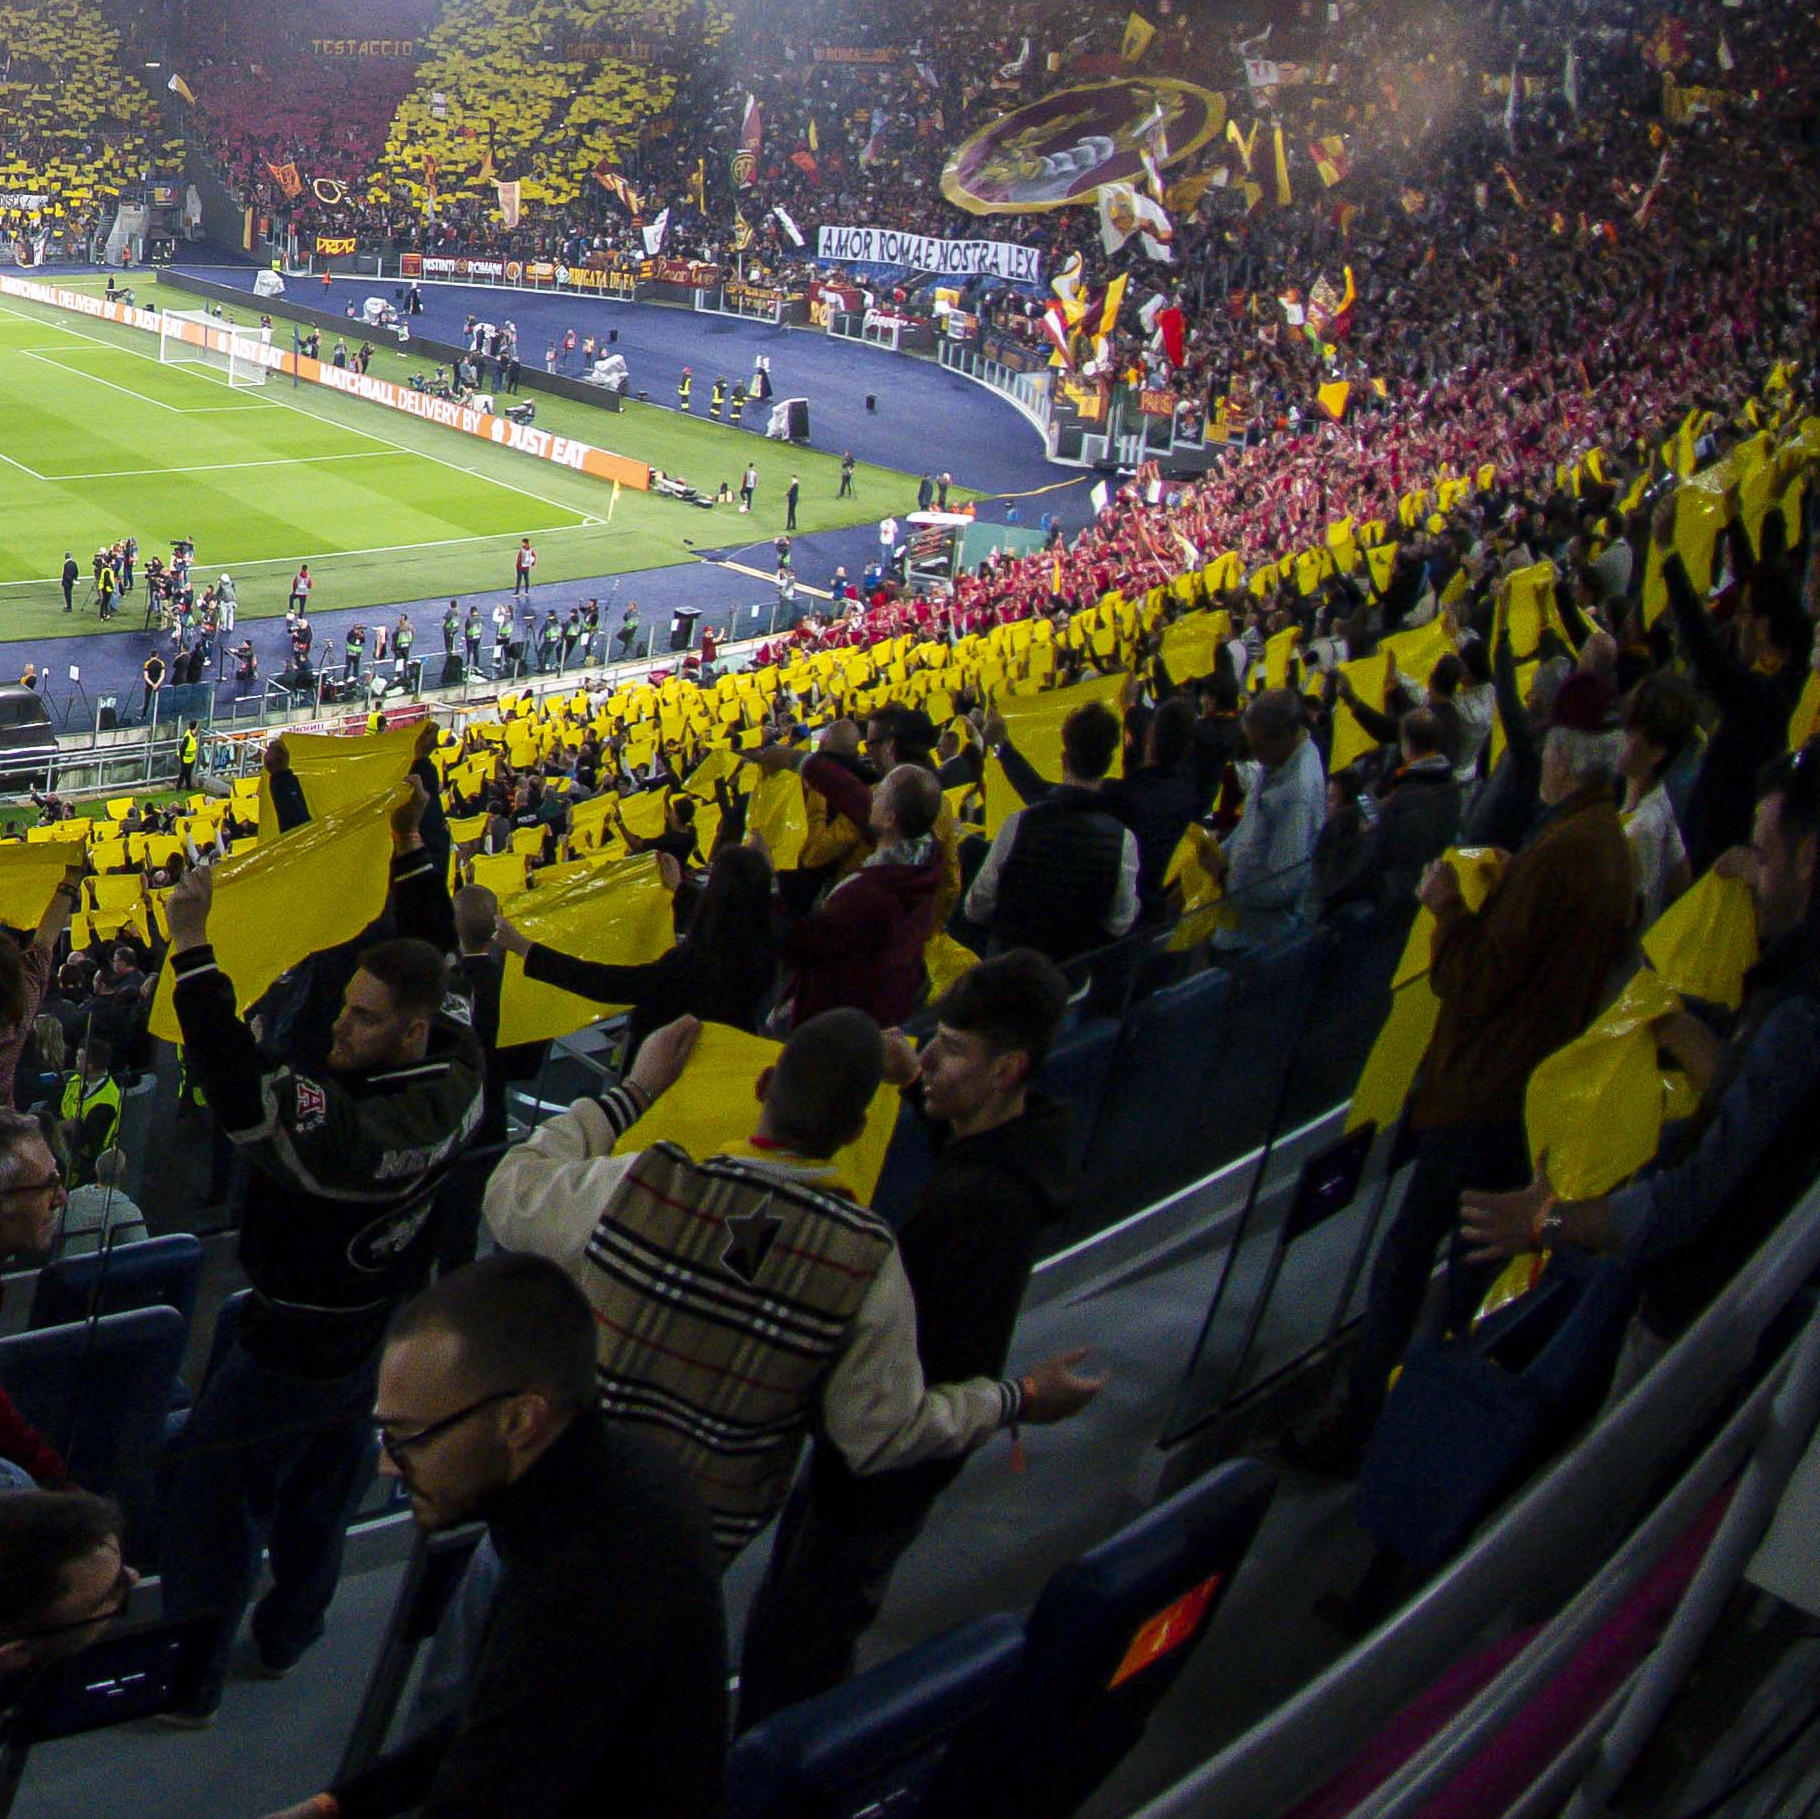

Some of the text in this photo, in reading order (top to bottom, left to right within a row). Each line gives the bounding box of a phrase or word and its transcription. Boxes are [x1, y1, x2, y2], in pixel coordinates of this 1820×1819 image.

[822, 228, 1036, 282] AMOR ROMAE NOSTRA LEX
[1, 276, 117, 320] MATCHBALL DELIVERY BY
[133, 307, 162, 331] JUST
[320, 363, 483, 434] MATCHBALL DELIVERY BY
[506, 420, 591, 470] JUST EAT
